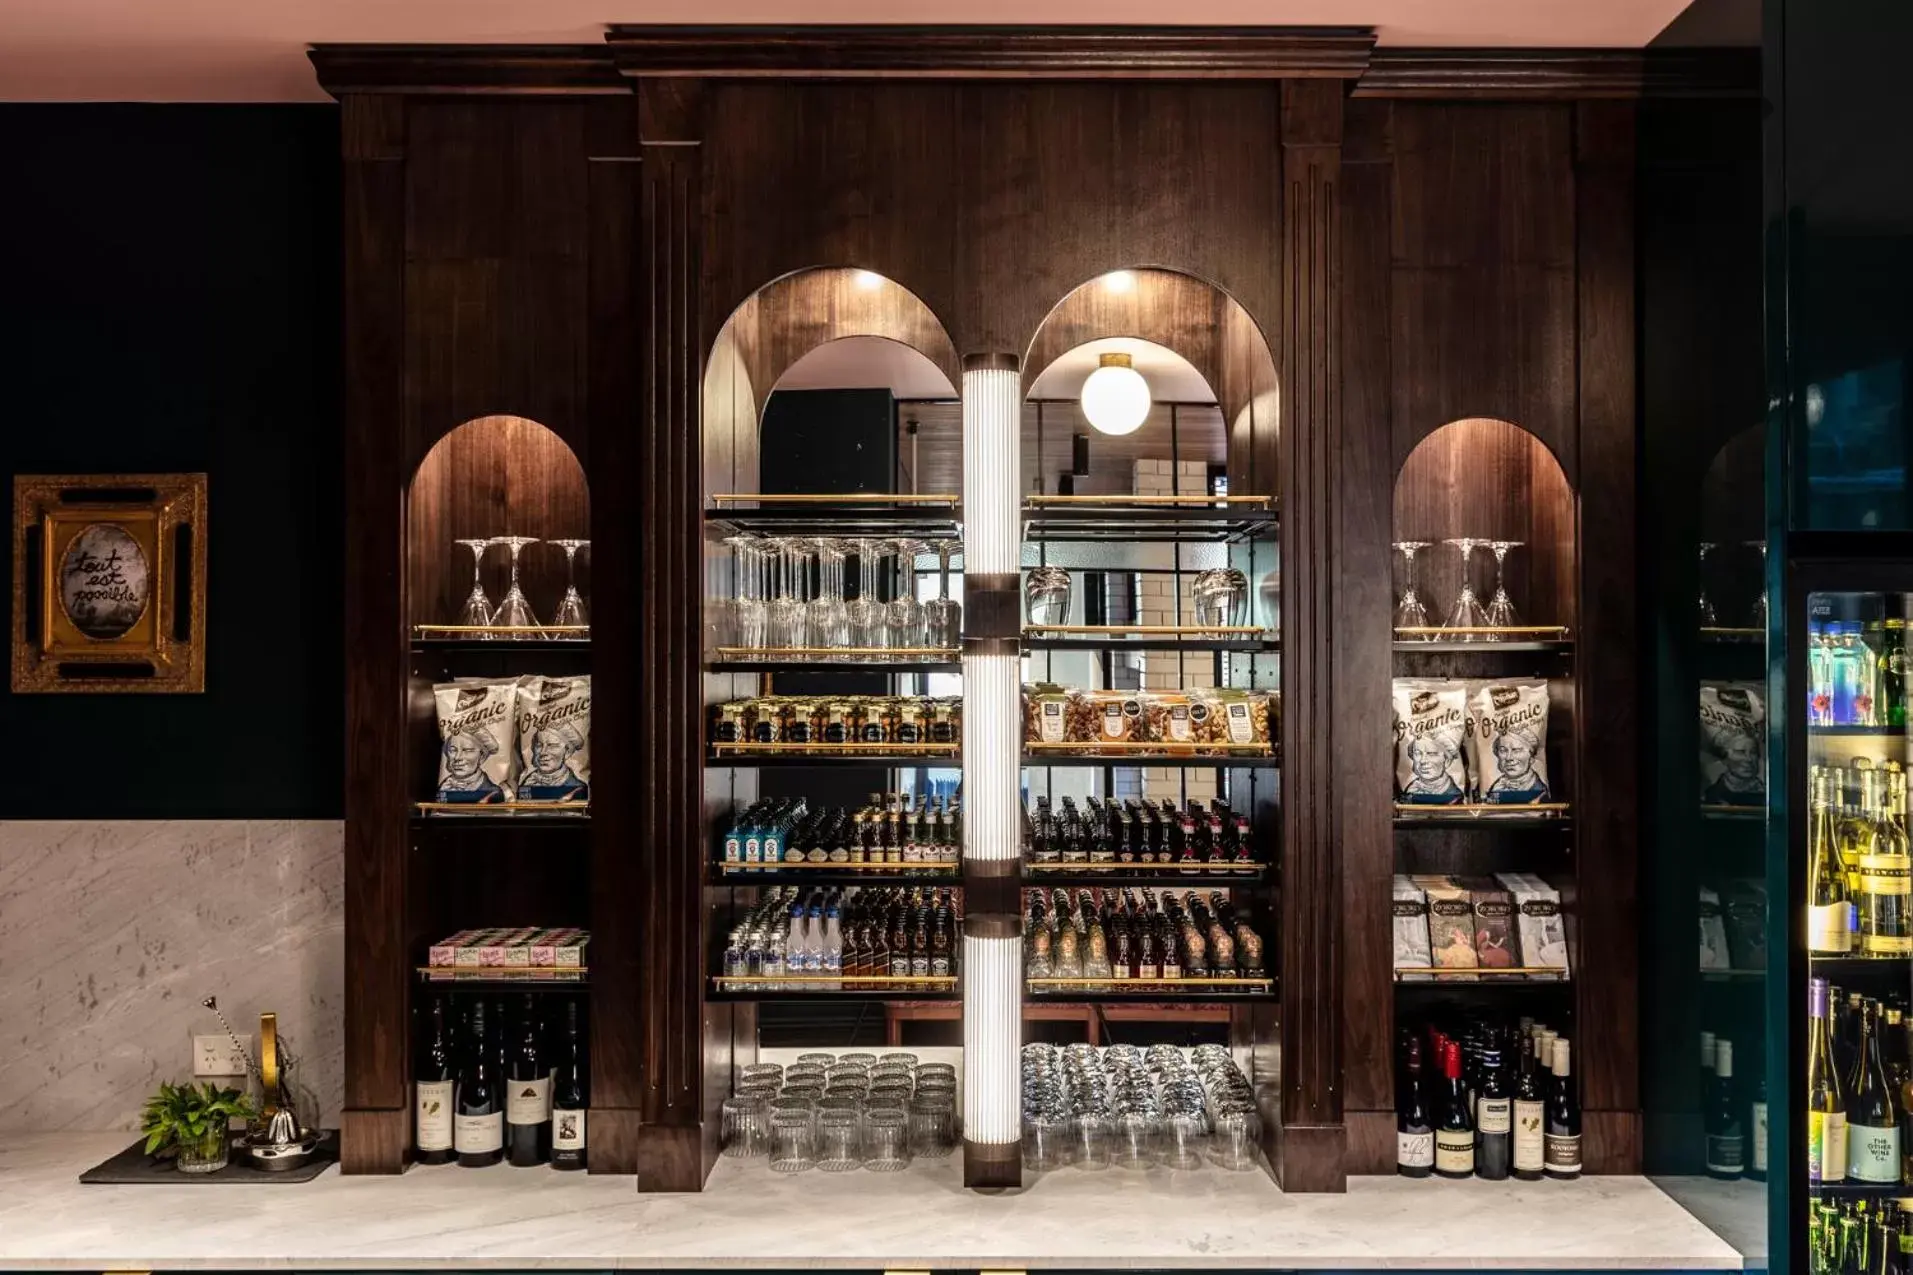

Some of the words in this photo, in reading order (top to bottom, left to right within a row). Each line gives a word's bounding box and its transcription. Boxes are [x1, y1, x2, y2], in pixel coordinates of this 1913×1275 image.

[69, 549, 122, 576] tout
[84, 571, 127, 587] est
[521, 696, 590, 735] Organic
[1482, 702, 1542, 739] Organic
